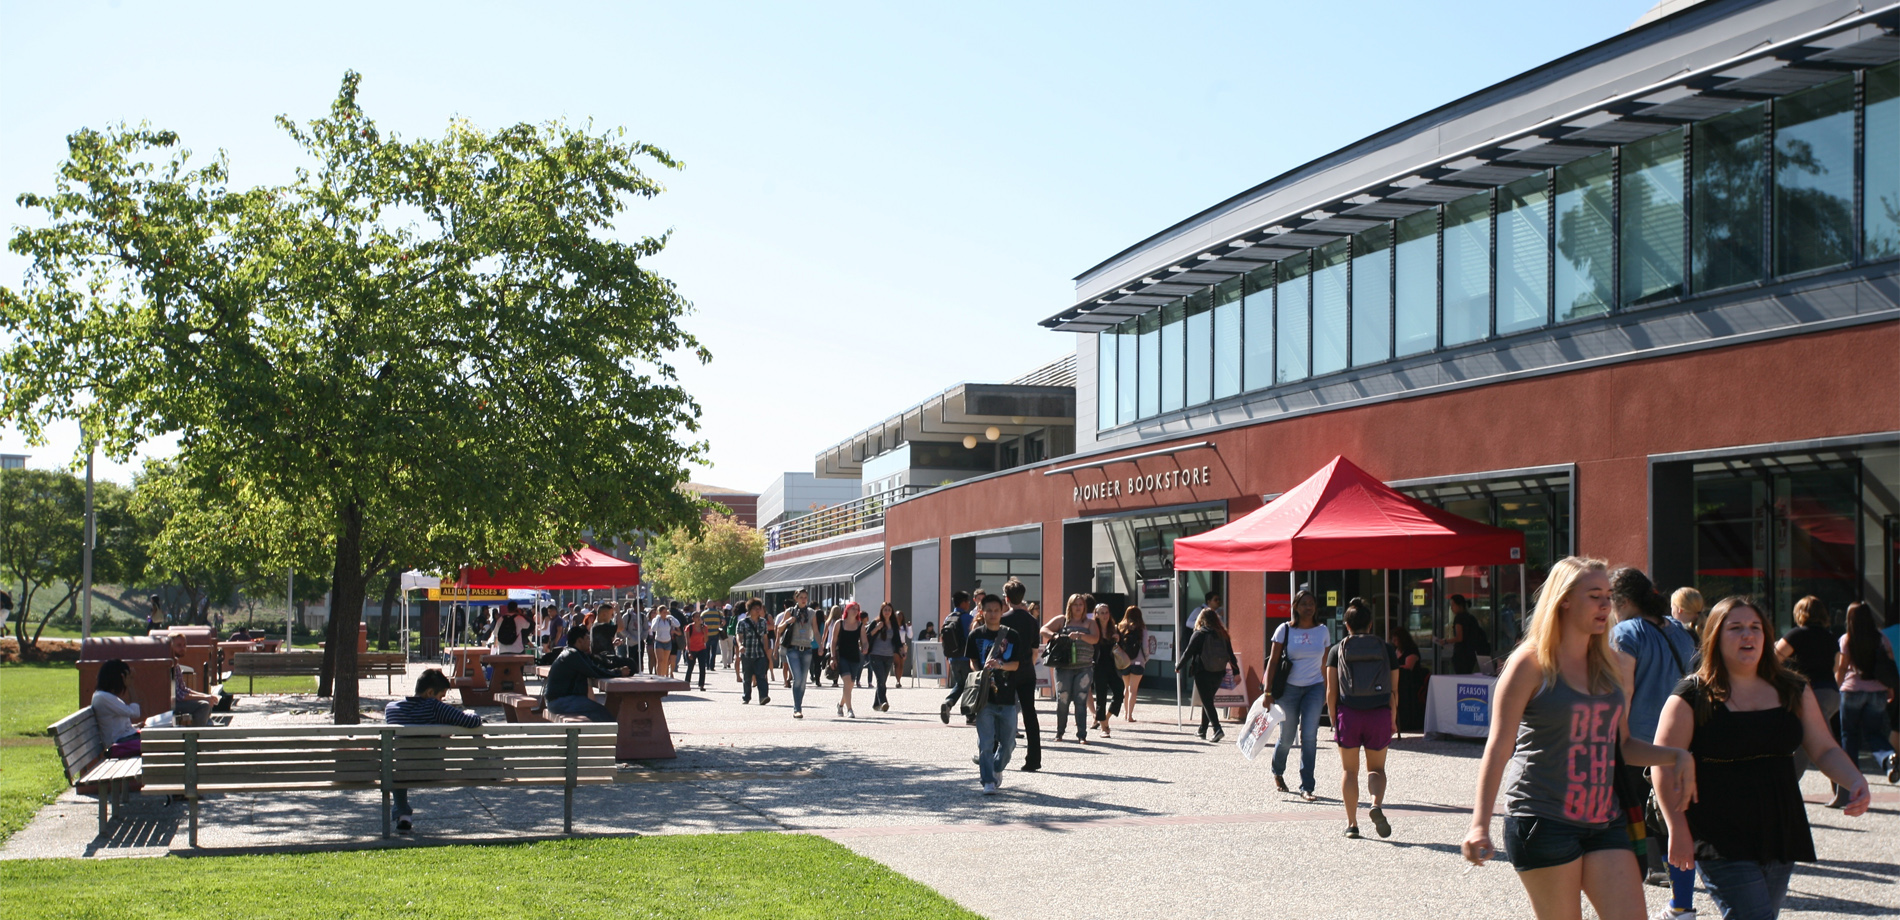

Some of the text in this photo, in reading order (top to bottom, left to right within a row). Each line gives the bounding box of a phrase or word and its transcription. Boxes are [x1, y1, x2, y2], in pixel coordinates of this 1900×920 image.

[1073, 466, 1209, 502] PIONEER BOOKSTORE
[1458, 686, 1486, 696] PEARSON
[1460, 703, 1481, 713] Prentice
[1473, 713, 1484, 722] Hall
